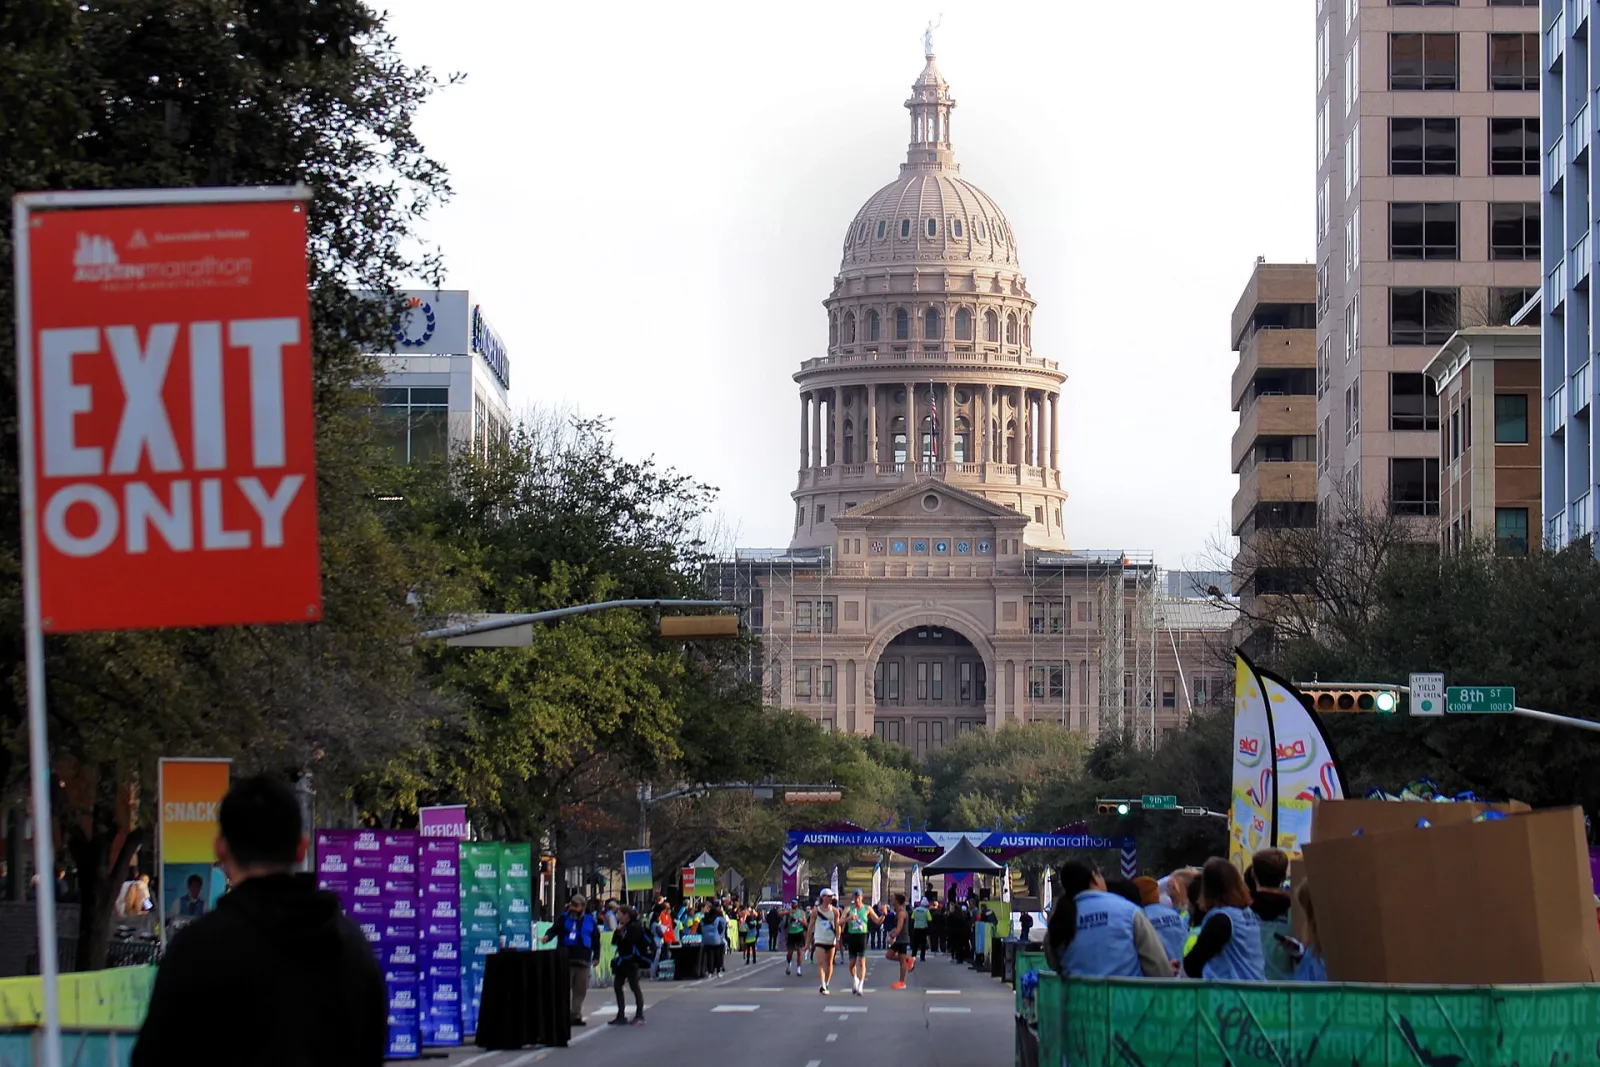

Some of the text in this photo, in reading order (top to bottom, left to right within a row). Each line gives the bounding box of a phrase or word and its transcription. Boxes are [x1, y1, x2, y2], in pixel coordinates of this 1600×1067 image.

[39, 317, 300, 478] EXIT
[43, 475, 306, 558] ONLY
[1417, 684, 1436, 692] YIELD
[1459, 689, 1502, 703] 8th ST
[1149, 796, 1162, 805] 9th
[164, 801, 222, 822] SNACK
[627, 865, 650, 875] WATER
